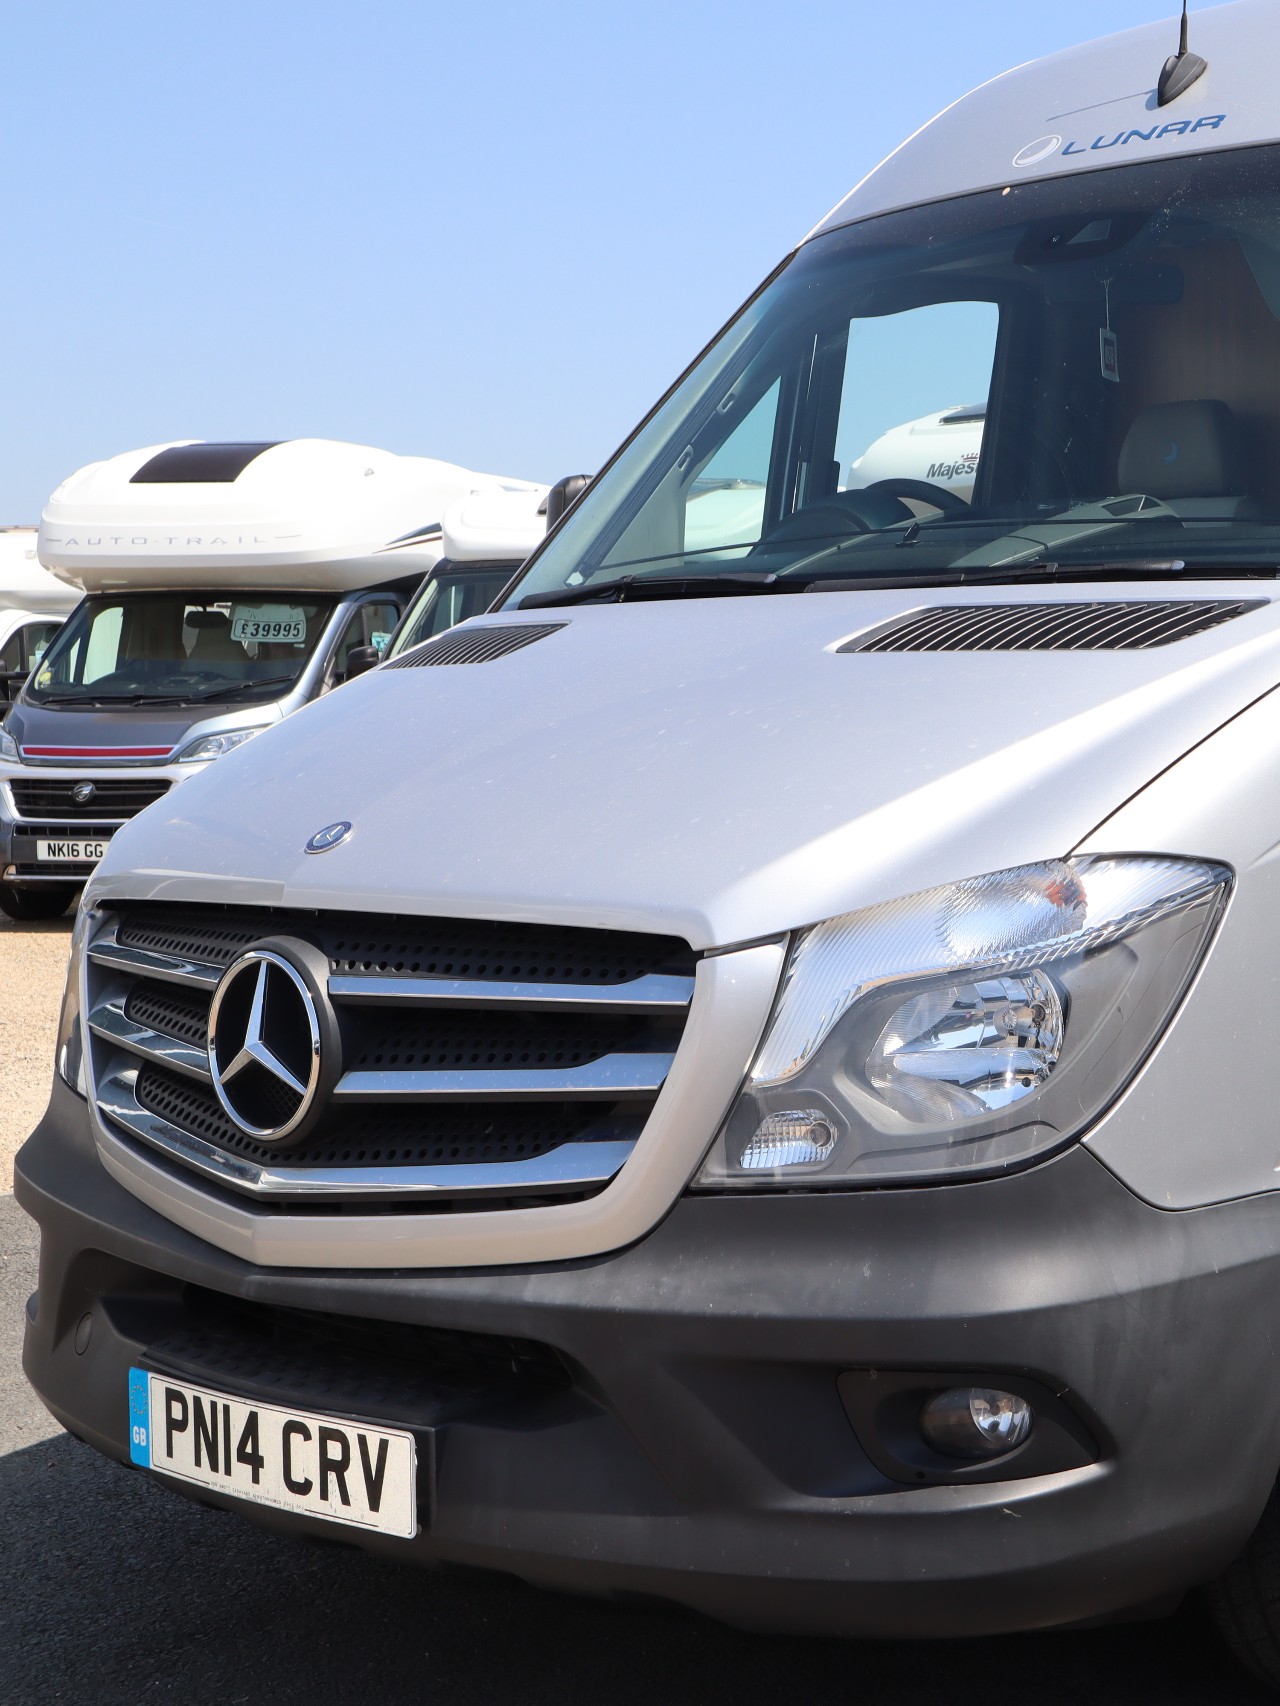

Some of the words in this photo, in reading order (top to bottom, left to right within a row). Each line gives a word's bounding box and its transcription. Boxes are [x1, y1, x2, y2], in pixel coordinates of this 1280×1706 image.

[1061, 114, 1227, 156] LUNAR
[926, 460, 978, 480] Majes
[241, 622, 301, 637] £39995
[47, 842, 80, 858] NK16
[132, 1425, 147, 1447] GB
[164, 1386, 265, 1485] PN14
[281, 1419, 390, 1513] CRV
